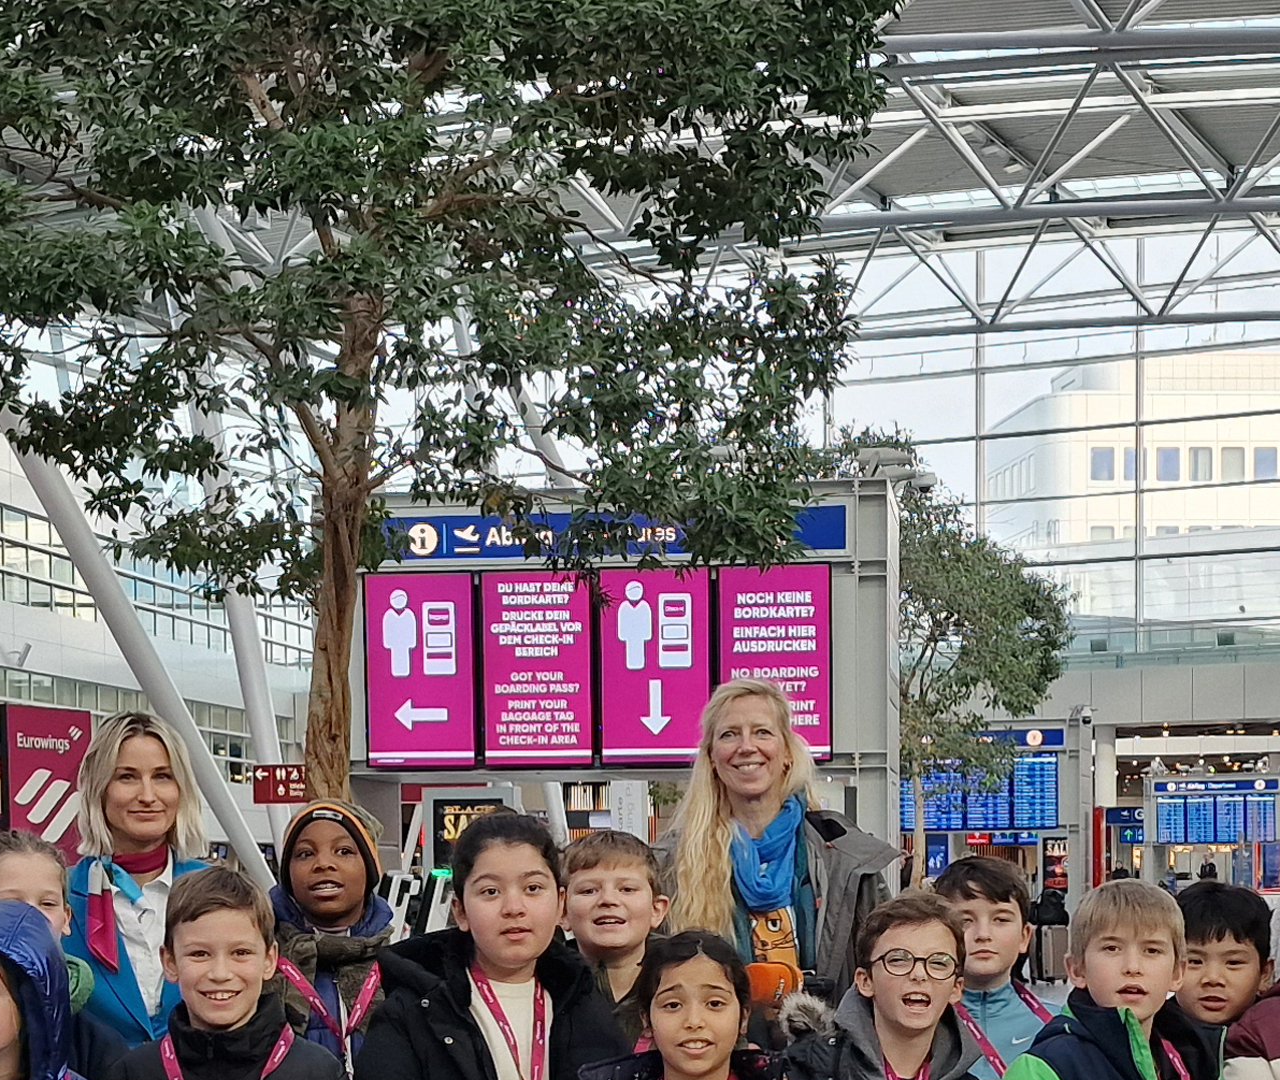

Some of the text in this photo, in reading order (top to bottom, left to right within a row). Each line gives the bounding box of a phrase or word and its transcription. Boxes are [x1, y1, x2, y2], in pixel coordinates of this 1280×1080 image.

[498, 583, 513, 593] DU
[514, 582, 542, 593] HAST
[502, 594, 570, 605] BORDKARTE?
[736, 591, 812, 604] NOCH KEINE
[502, 610, 570, 621] DRUCKE DEIN
[734, 606, 815, 619] BORDKARTE?
[560, 622, 582, 632] VOR
[733, 625, 816, 638] EINFACH HIER
[499, 634, 574, 645] DEM CHECK-IN
[515, 646, 559, 657] BEREICH
[733, 639, 816, 653] AUSDRUCKEN
[510, 671, 564, 681] GOT YOUR
[731, 666, 820, 679] NO BOARDING
[495, 683, 580, 694] BOARDING PASS?
[778, 681, 807, 692] YET?
[508, 699, 568, 710] PRINT YOUR
[790, 700, 816, 711] RINT
[501, 712, 575, 722] BAGGAGE TAG
[496, 723, 580, 733] IN FRONT OF THE
[16, 732, 71, 754] Eurowings
[499, 735, 578, 745] CHECK-IN AREA
